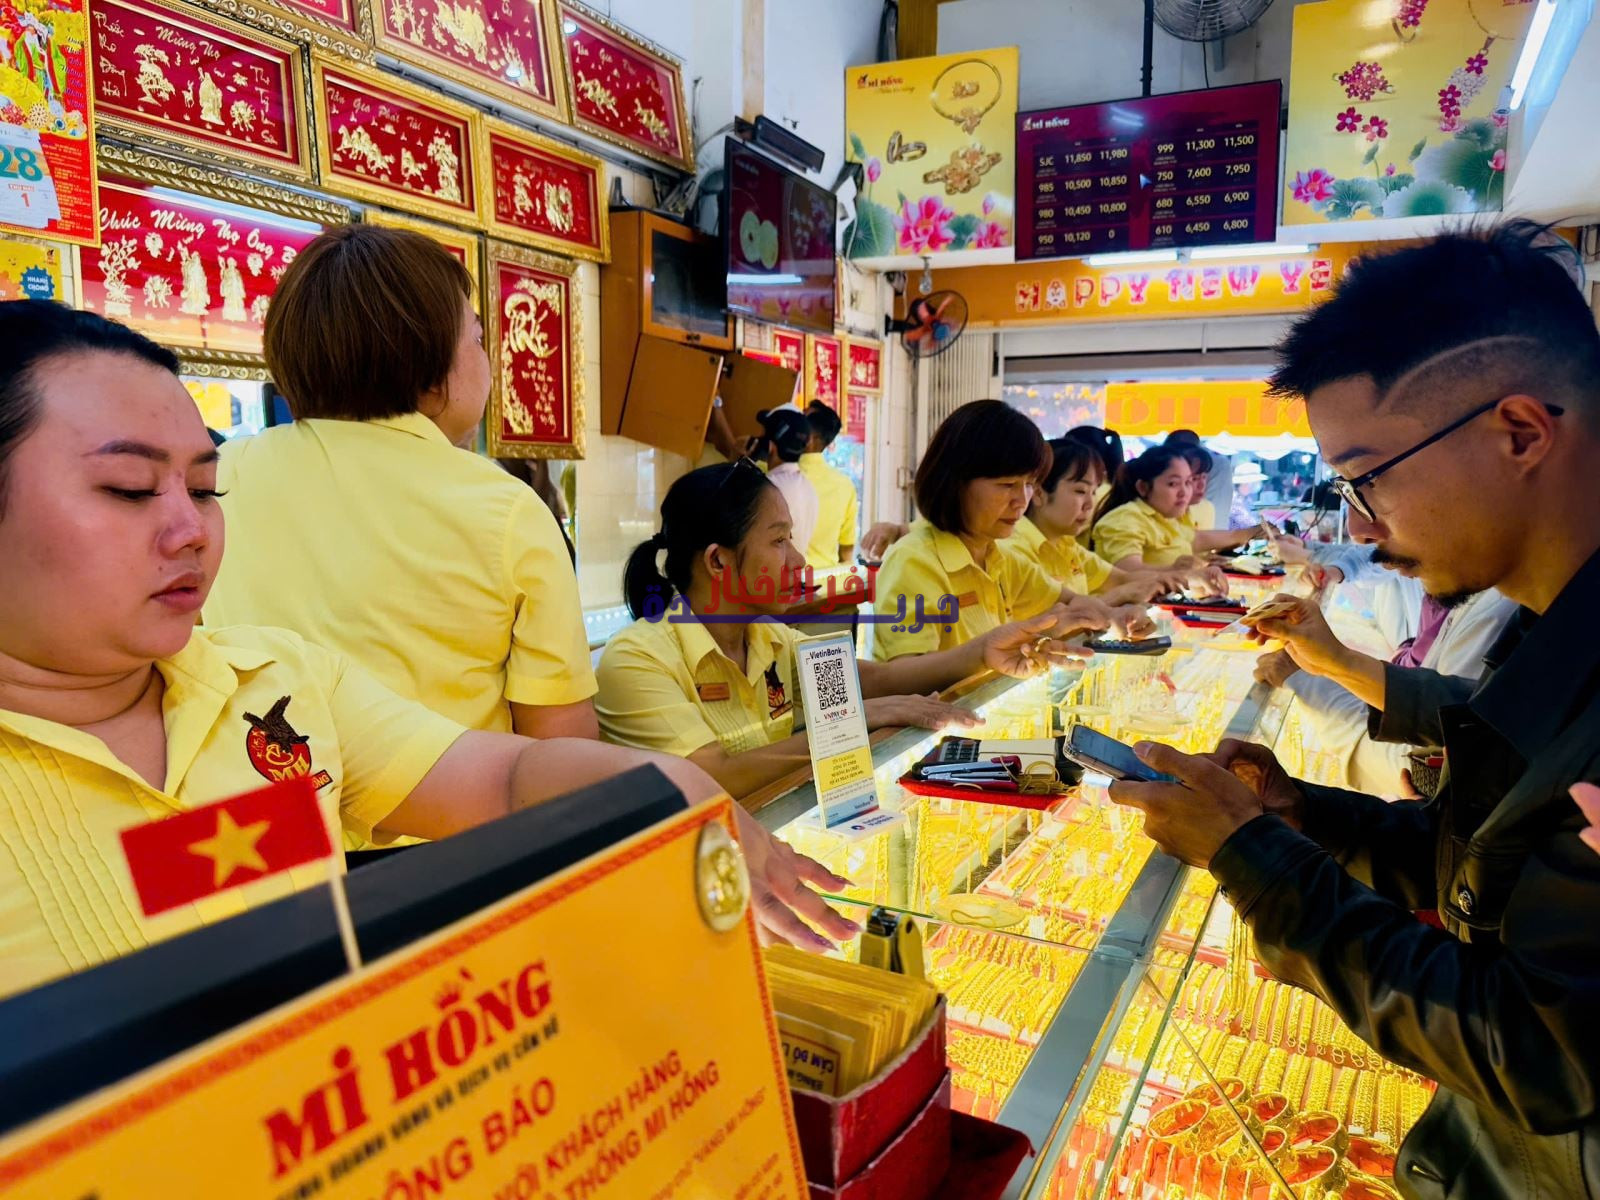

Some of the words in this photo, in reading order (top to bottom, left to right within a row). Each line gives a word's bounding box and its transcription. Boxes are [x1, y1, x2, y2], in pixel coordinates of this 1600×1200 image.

[1157, 144, 1174, 153] 999
[1186, 139, 1215, 151] 11,300
[1224, 135, 1254, 147] 11,500
[0, 145, 43, 181] 28
[1064, 153, 1092, 164] 11,850
[1100, 149, 1128, 160] 11,980
[1157, 171, 1174, 181] 750
[1187, 167, 1211, 179] 7,600
[1225, 163, 1250, 175] 7,950
[1065, 179, 1092, 190] 10,500
[1100, 175, 1127, 187] 10,850
[1156, 198, 1173, 208] 680
[1186, 194, 1211, 206] 6,550
[1224, 191, 1249, 203] 6,900
[1064, 205, 1091, 217] 10,450
[1099, 202, 1126, 214] 10,800
[99, 207, 141, 231] Chúc
[150, 209, 206, 241] Mừng
[212, 218, 240, 245] Thọ
[246, 228, 274, 260] Ông
[1064, 232, 1091, 243] 10,120
[1108, 229, 1115, 239] 0
[1155, 225, 1173, 235] 610
[1185, 222, 1210, 233] 6,450
[1223, 219, 1249, 231] 6,800
[1015, 273, 1150, 311] HAPPY
[1166, 264, 1260, 302] NEW
[810, 645, 842, 660] VietinBank
[382, 959, 553, 1105] HỒNG
[545, 1095, 626, 1180] KHÁCH
[626, 1049, 682, 1111] HÀNG
[643, 1105, 668, 1143] MI
[384, 1136, 475, 1200] ÔNG
[480, 1076, 556, 1156] BÁO
